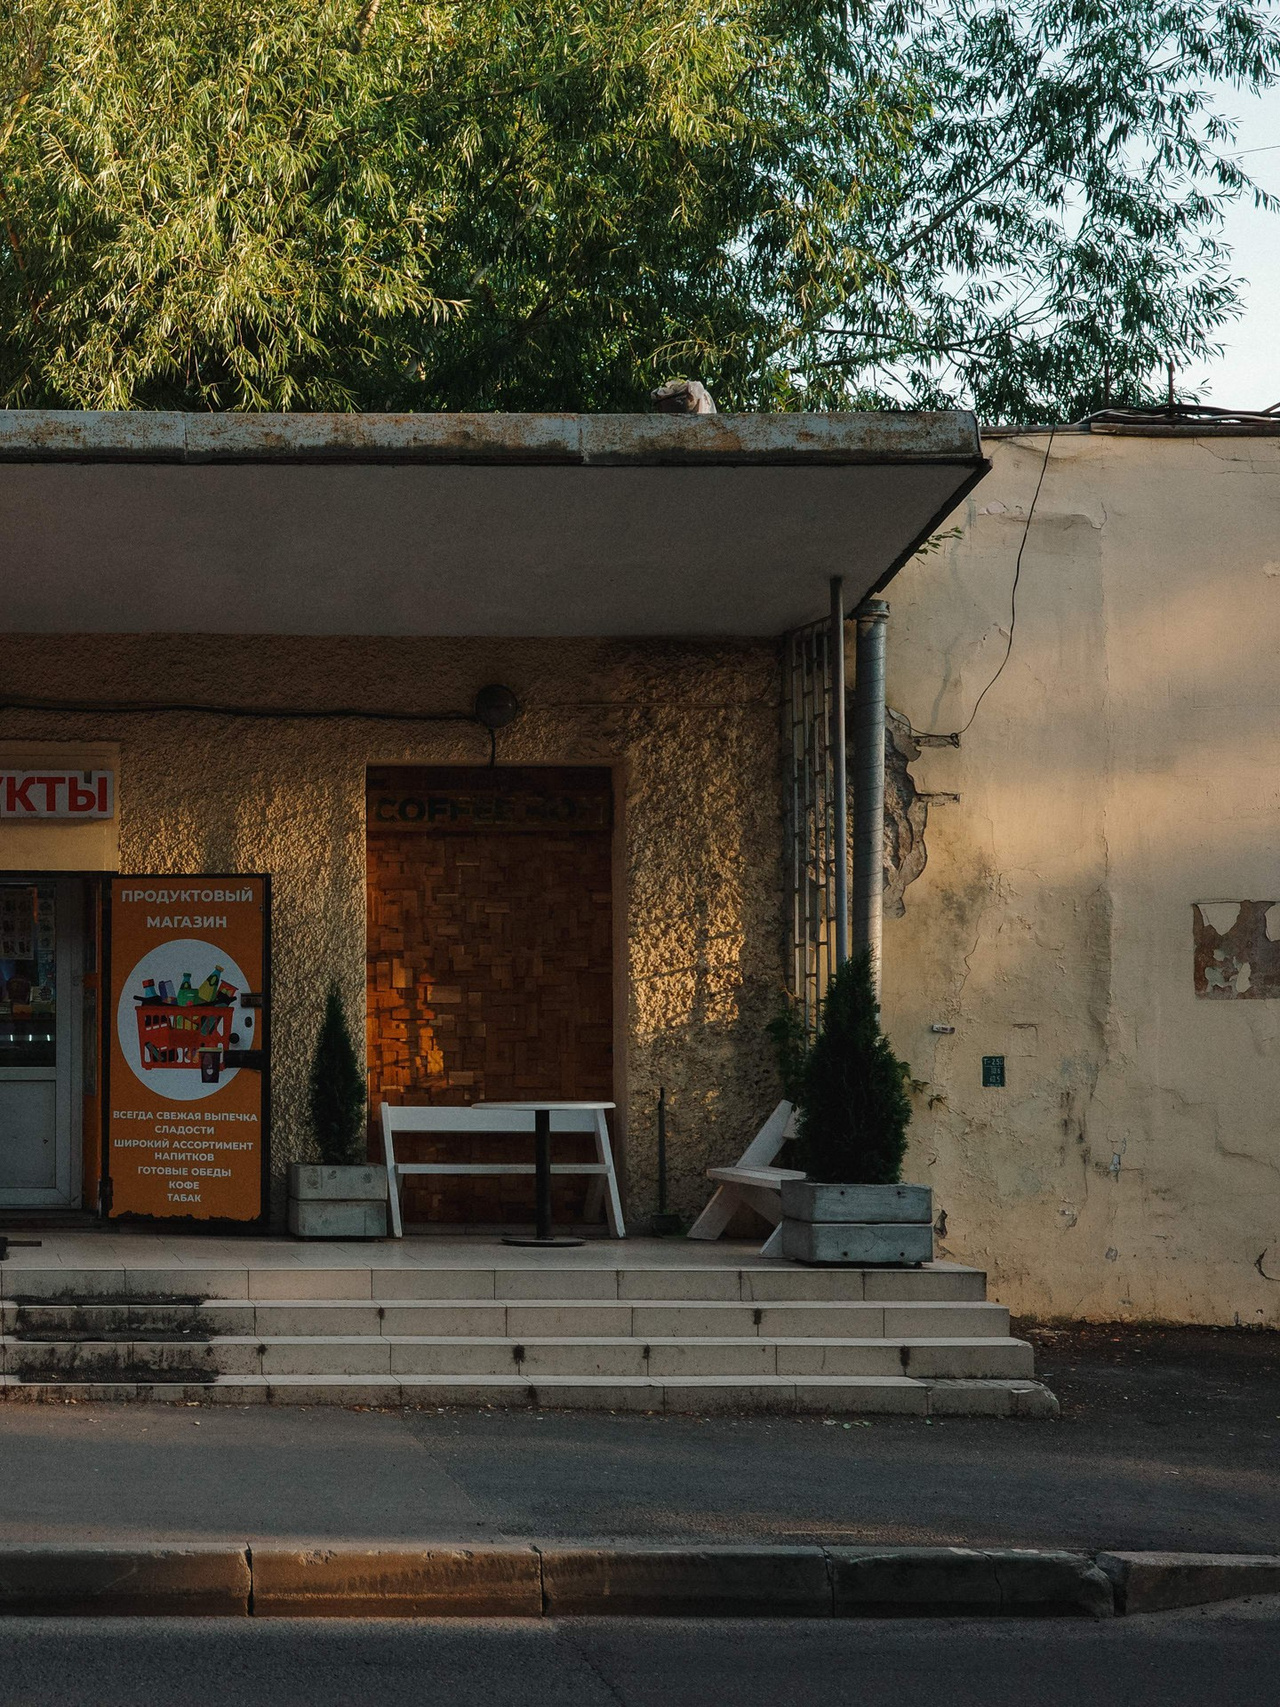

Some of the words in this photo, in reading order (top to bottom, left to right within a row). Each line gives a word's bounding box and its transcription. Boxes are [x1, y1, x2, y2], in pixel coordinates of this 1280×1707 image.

[121, 886, 253, 904] ПРОДУКТОВЫЙ
[147, 916, 227, 928] МАГАЗИН
[113, 1111, 153, 1120] ВСЕГДА
[156, 1112, 201, 1120] СВЕЖАЯ
[204, 1113, 258, 1122] ВЫПЕЧКА
[154, 1125, 215, 1135] СЛАДОСТИ
[114, 1138, 169, 1148] ШИРОКИЙ
[172, 1140, 254, 1150] АССОРТИМЕНТ
[154, 1152, 215, 1161] НАПИТКОВ
[138, 1166, 188, 1176] ГОТОВЫЕ
[191, 1168, 232, 1178] ОБЕДЫ
[169, 1181, 200, 1190] КОФЕ
[167, 1193, 202, 1202] ТАБАК
